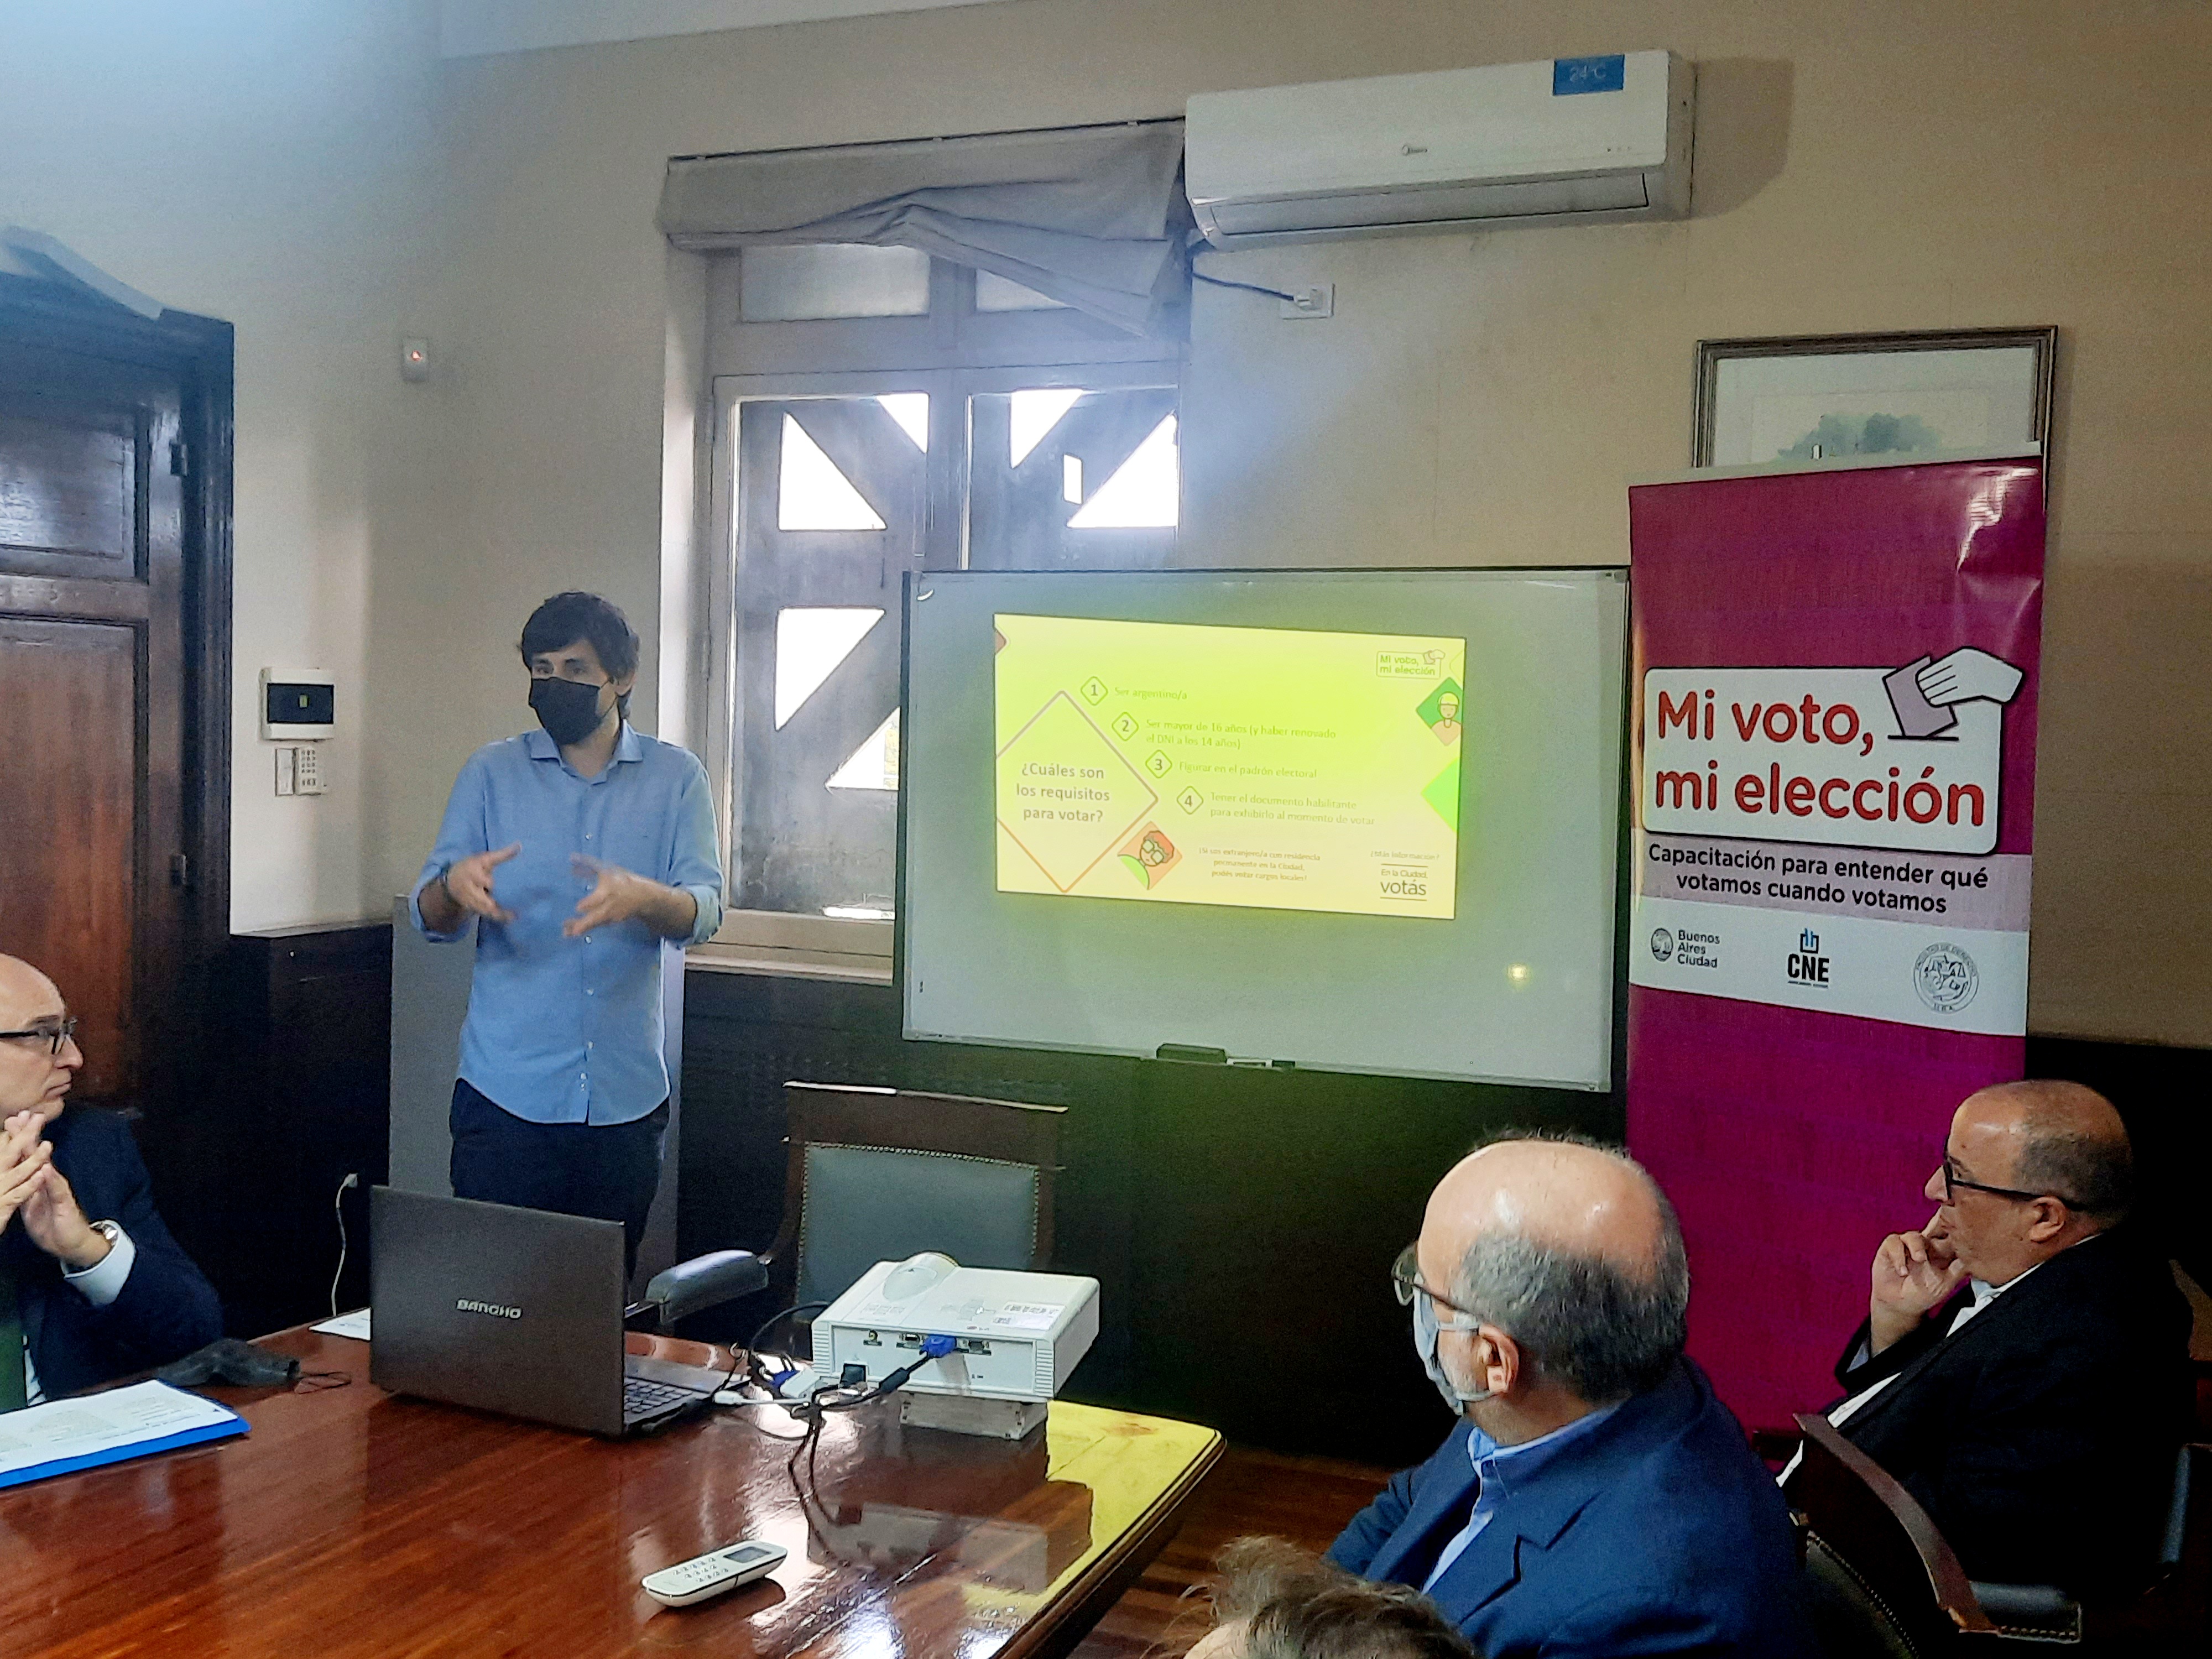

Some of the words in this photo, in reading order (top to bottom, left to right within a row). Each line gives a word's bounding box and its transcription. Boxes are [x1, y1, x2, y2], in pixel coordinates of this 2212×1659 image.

[1395, 665, 1435, 675] elección
[1091, 685, 1098, 696] 1
[1115, 687, 1129, 695] Ser
[1133, 690, 1187, 700] argentino/a
[1122, 720, 1129, 732] 2
[1146, 719, 1160, 728] Ser
[1164, 722, 1193, 732] mayor
[1196, 722, 1208, 731] de
[1212, 723, 1222, 732] 16
[1225, 724, 1246, 733] años
[1249, 725, 1259, 735] (y
[1261, 725, 1288, 736] haber
[1291, 729, 1336, 738] renovado
[1658, 688, 1715, 741] Mi
[1731, 694, 1874, 757] voto,
[1146, 734, 1154, 743] el
[1157, 734, 1174, 744] DNI
[1185, 737, 1198, 745] los
[1202, 737, 1212, 746] 14
[1215, 739, 1240, 749] años)
[1022, 763, 1075, 777] ¿Cuáles
[1080, 769, 1104, 779] son
[1155, 759, 1162, 770] 3
[1180, 761, 1211, 773] Figurar
[1229, 764, 1237, 773] el
[1240, 766, 1273, 776] padrón
[1276, 768, 1317, 778] electoral
[1016, 783, 1036, 796] los
[1041, 787, 1110, 801] requisitos
[1656, 759, 1718, 811] mi
[1734, 762, 1984, 826] elección
[1185, 795, 1193, 807] 4
[1211, 792, 1236, 801] Tener
[1239, 794, 1247, 802] el
[1250, 795, 1303, 806] documento
[1306, 798, 1357, 809] habilitante
[1024, 809, 1054, 821] para
[1058, 810, 1103, 822] votar?
[1211, 808, 1230, 817] para
[1234, 808, 1274, 819] exhibirlo
[1277, 811, 1285, 820] al
[1287, 813, 1333, 823] momento
[1336, 815, 1348, 824] de
[1648, 843, 1775, 872] Capacitación
[1782, 857, 1828, 877] para
[1834, 858, 1933, 885] entender
[1940, 866, 1988, 890] qué
[1380, 879, 1426, 895] votás
[1676, 874, 1761, 896] votamos
[1768, 881, 1845, 903] cuando
[1851, 890, 1947, 914] votamos
[1678, 930, 1720, 944] Buenos
[1677, 943, 1705, 954] Aires
[1677, 954, 1718, 968] Ciudad
[1787, 953, 1829, 982] CNE
